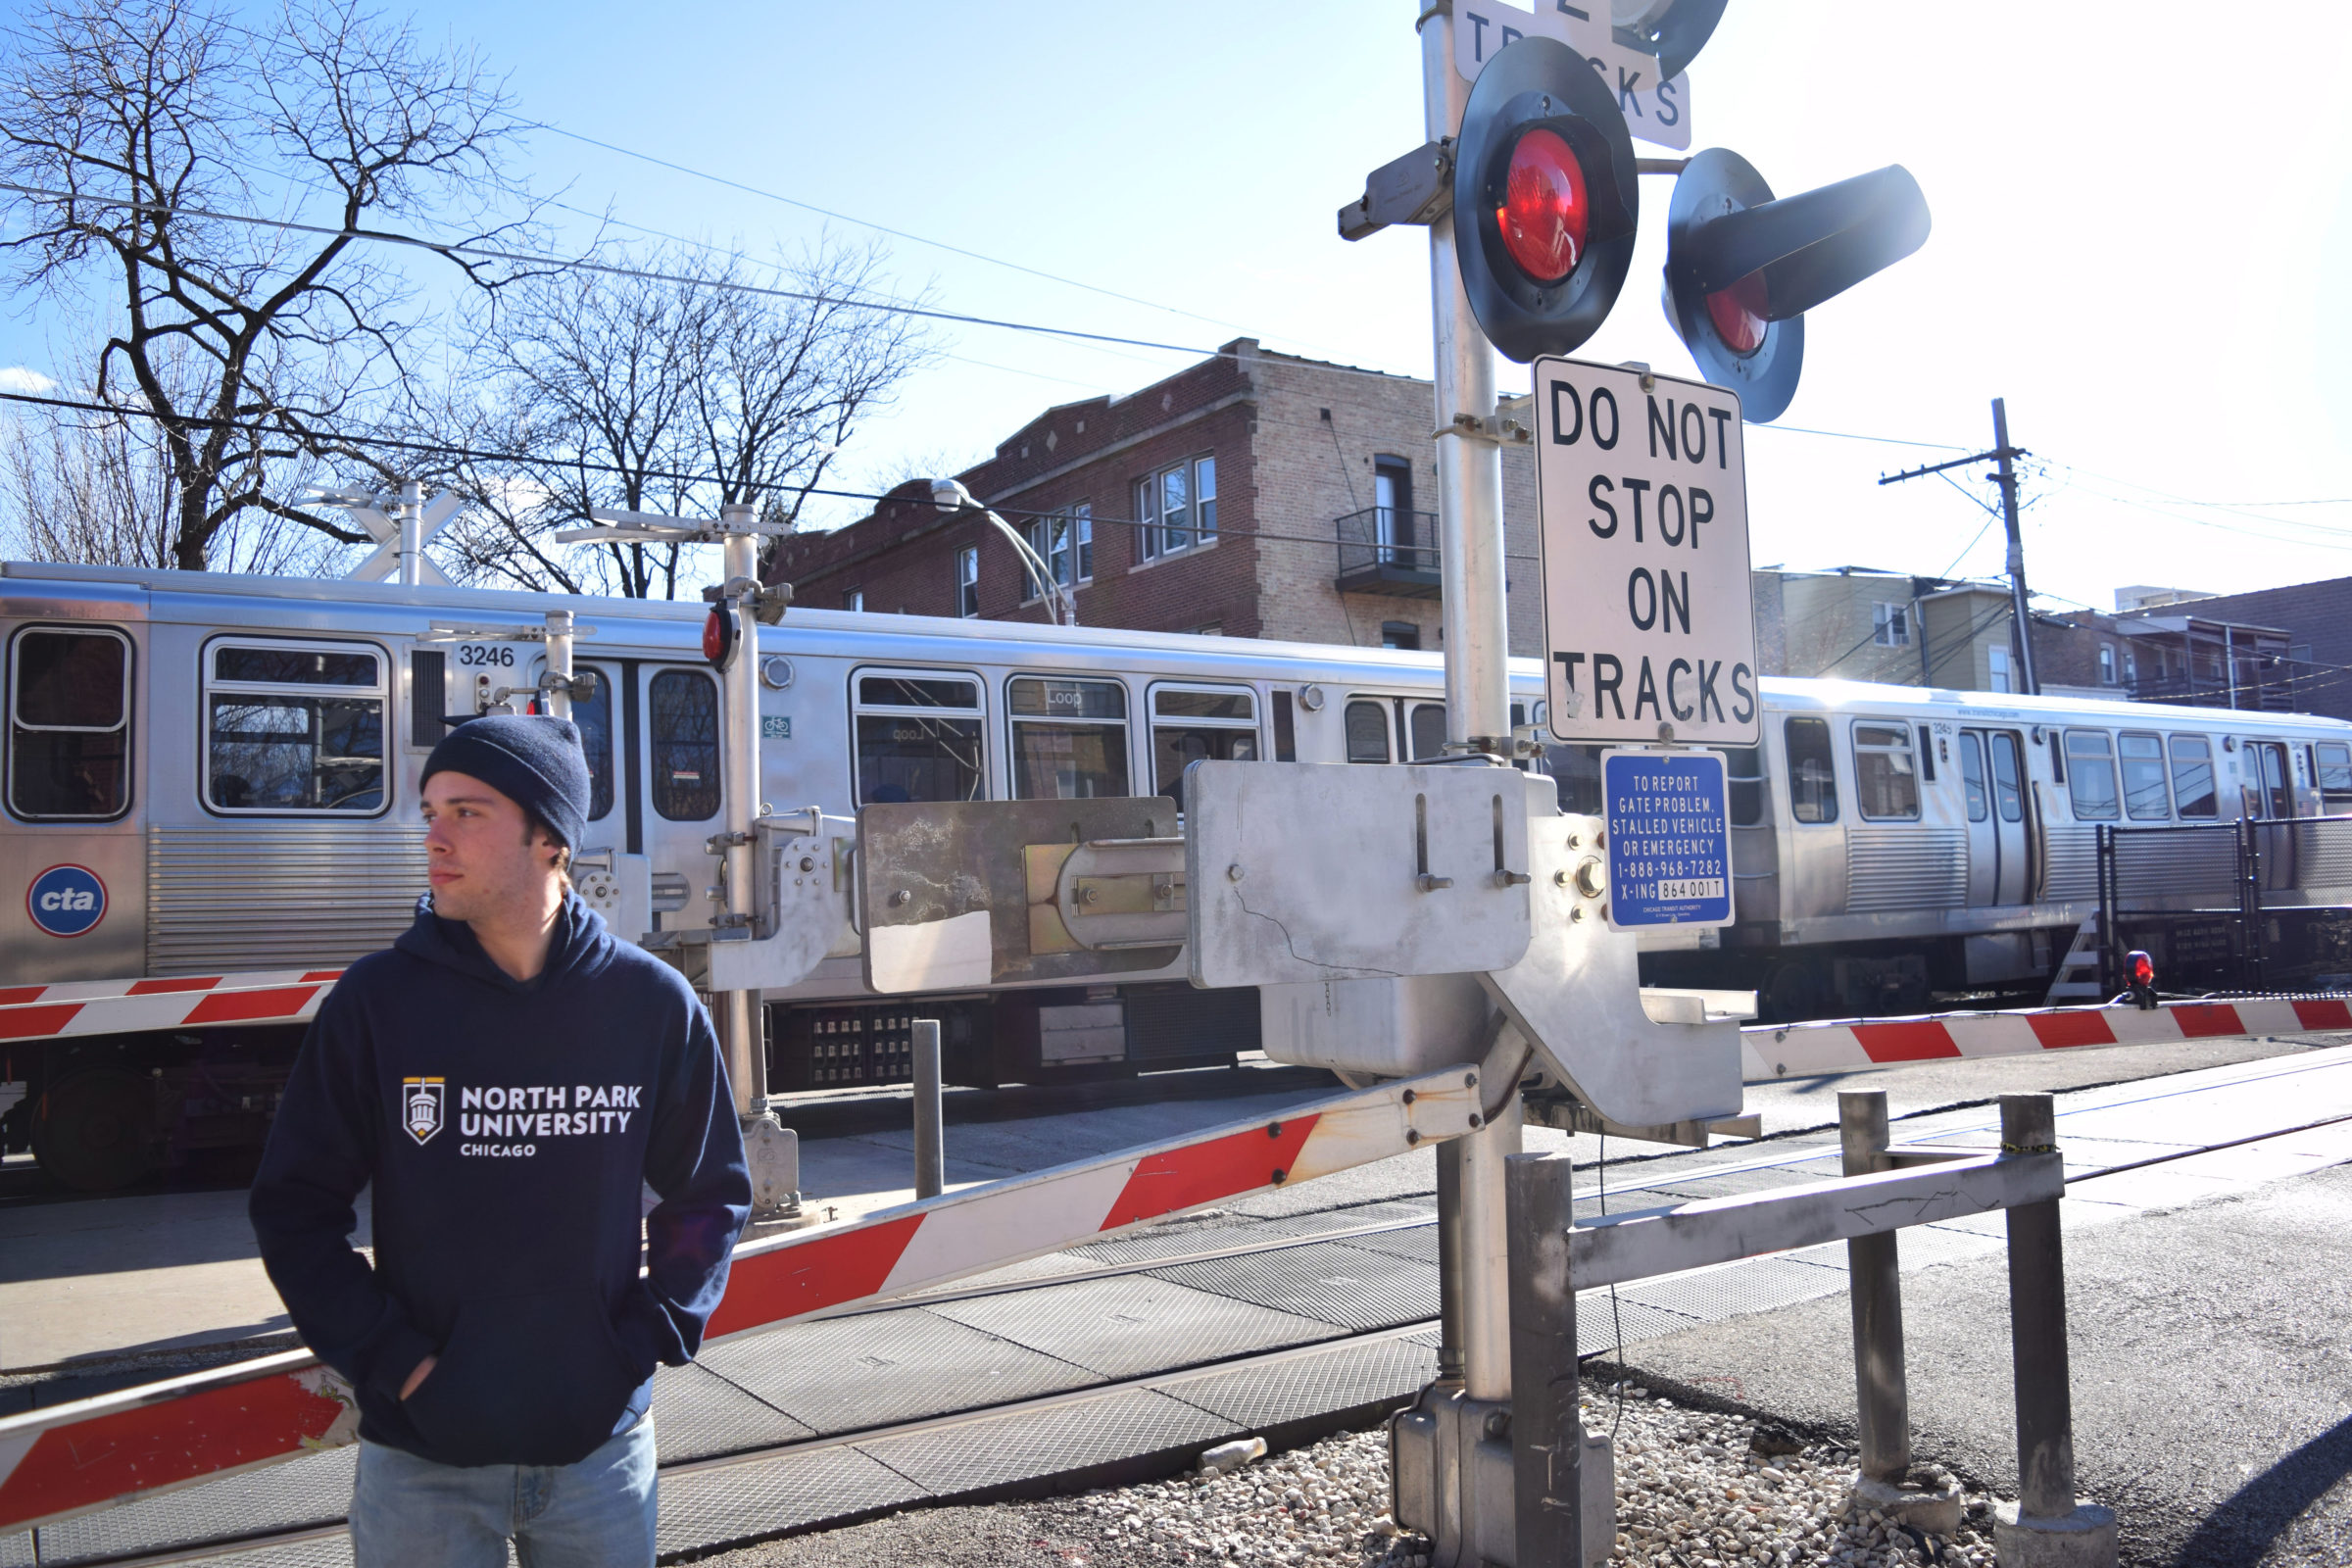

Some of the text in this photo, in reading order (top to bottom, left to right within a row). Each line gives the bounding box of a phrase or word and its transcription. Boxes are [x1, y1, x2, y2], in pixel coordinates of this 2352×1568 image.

[1467, 11, 1679, 126] TKS
[1550, 379, 1732, 469] DO NOT
[1588, 474, 1714, 550] STOP
[1628, 567, 1690, 635] ON
[460, 645, 514, 666] 3246
[1553, 651, 1754, 723] TRACKS
[1048, 689, 1082, 708] Loop
[1634, 775, 1698, 792] TO REPORT
[1619, 797, 1651, 813] GATE
[1612, 817, 1723, 835] STALLED VEHICLE
[1623, 839, 1714, 857] OR EMERGENCY
[1618, 859, 1721, 878] 1-888-968-7282
[40, 887, 94, 911] cta
[1621, 883, 1656, 900] X-ING
[1663, 882, 1686, 898] 864
[462, 1085, 642, 1110] NORTH PARK
[461, 1111, 631, 1137] UNIVERSITY
[460, 1144, 536, 1157] CHICAGO
